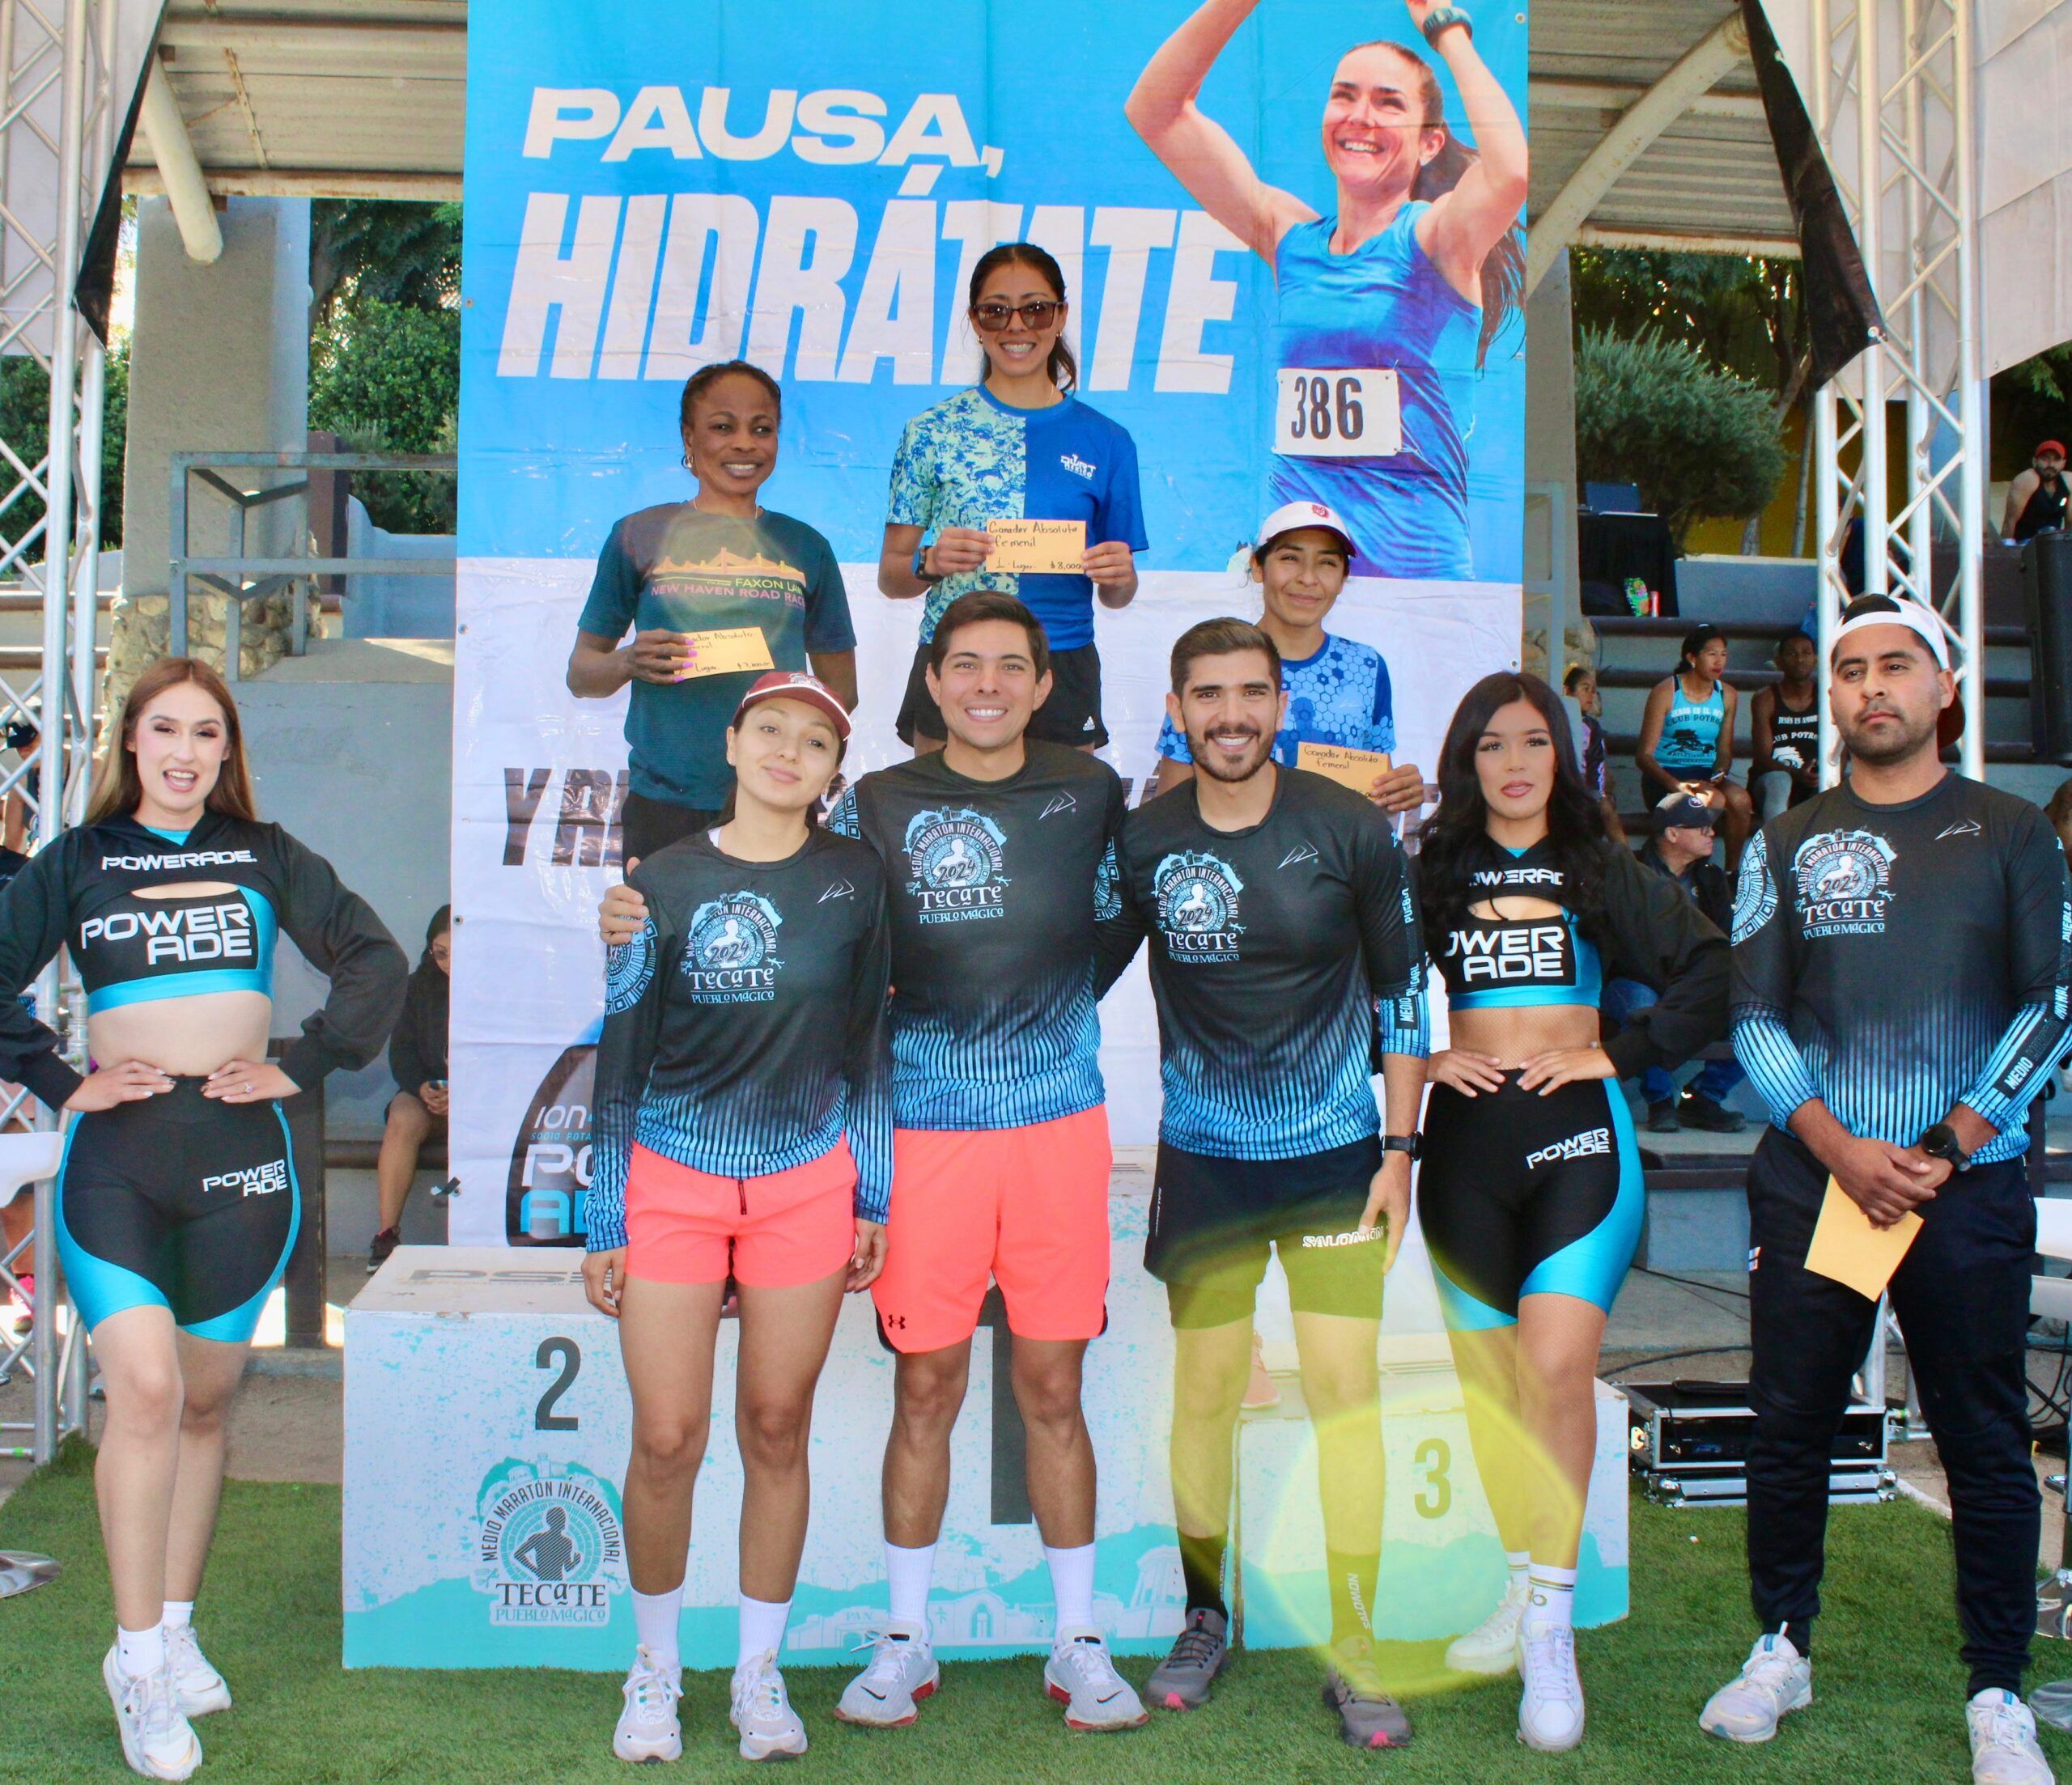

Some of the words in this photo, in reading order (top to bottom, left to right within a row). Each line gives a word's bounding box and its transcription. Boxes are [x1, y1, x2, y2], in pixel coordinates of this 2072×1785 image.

[523, 86, 1004, 178] PAUSA,
[1291, 376, 1364, 441] 386
[651, 583, 681, 596] NEW
[685, 583, 734, 596] HAVEN
[739, 588, 780, 600] ROAD
[736, 578, 783, 590] FAXON
[1693, 714, 1721, 725] POTRO
[912, 850, 923, 878] MEDIO
[957, 823, 1003, 872] INTERNACIONAL
[936, 859, 976, 885] 2024
[1198, 867, 1238, 919] INTERNACIONAL
[81, 902, 252, 950] POWER
[732, 904, 777, 954] INTERNACIONAL
[919, 912, 959, 924] PUEBLO
[1178, 904, 1212, 927] 2024
[146, 928, 253, 965] ADE
[1802, 924, 1841, 940] PUEBLO
[707, 939, 749, 965] 2024
[1169, 952, 1198, 964] PUEBLO
[1463, 952, 1564, 982] ADE
[692, 994, 730, 1003] PUEBLO
[1400, 997, 1414, 1023] MEDIO
[2004, 1056, 2033, 1090] MEDIO
[1526, 1127, 1609, 1169] POWER
[202, 1159, 285, 1192] POWER
[243, 1174, 287, 1198] ADE
[535, 1337, 581, 1431] 2
[1414, 1438, 1451, 1519] 3
[482, 1520, 502, 1562] MEDIO
[494, 1480, 553, 1520] MARATÓN
[558, 1482, 621, 1562] INTERNACIONAL
[496, 1609, 548, 1622] PUEBLO
[1347, 1573, 1371, 1630] SALOMON
